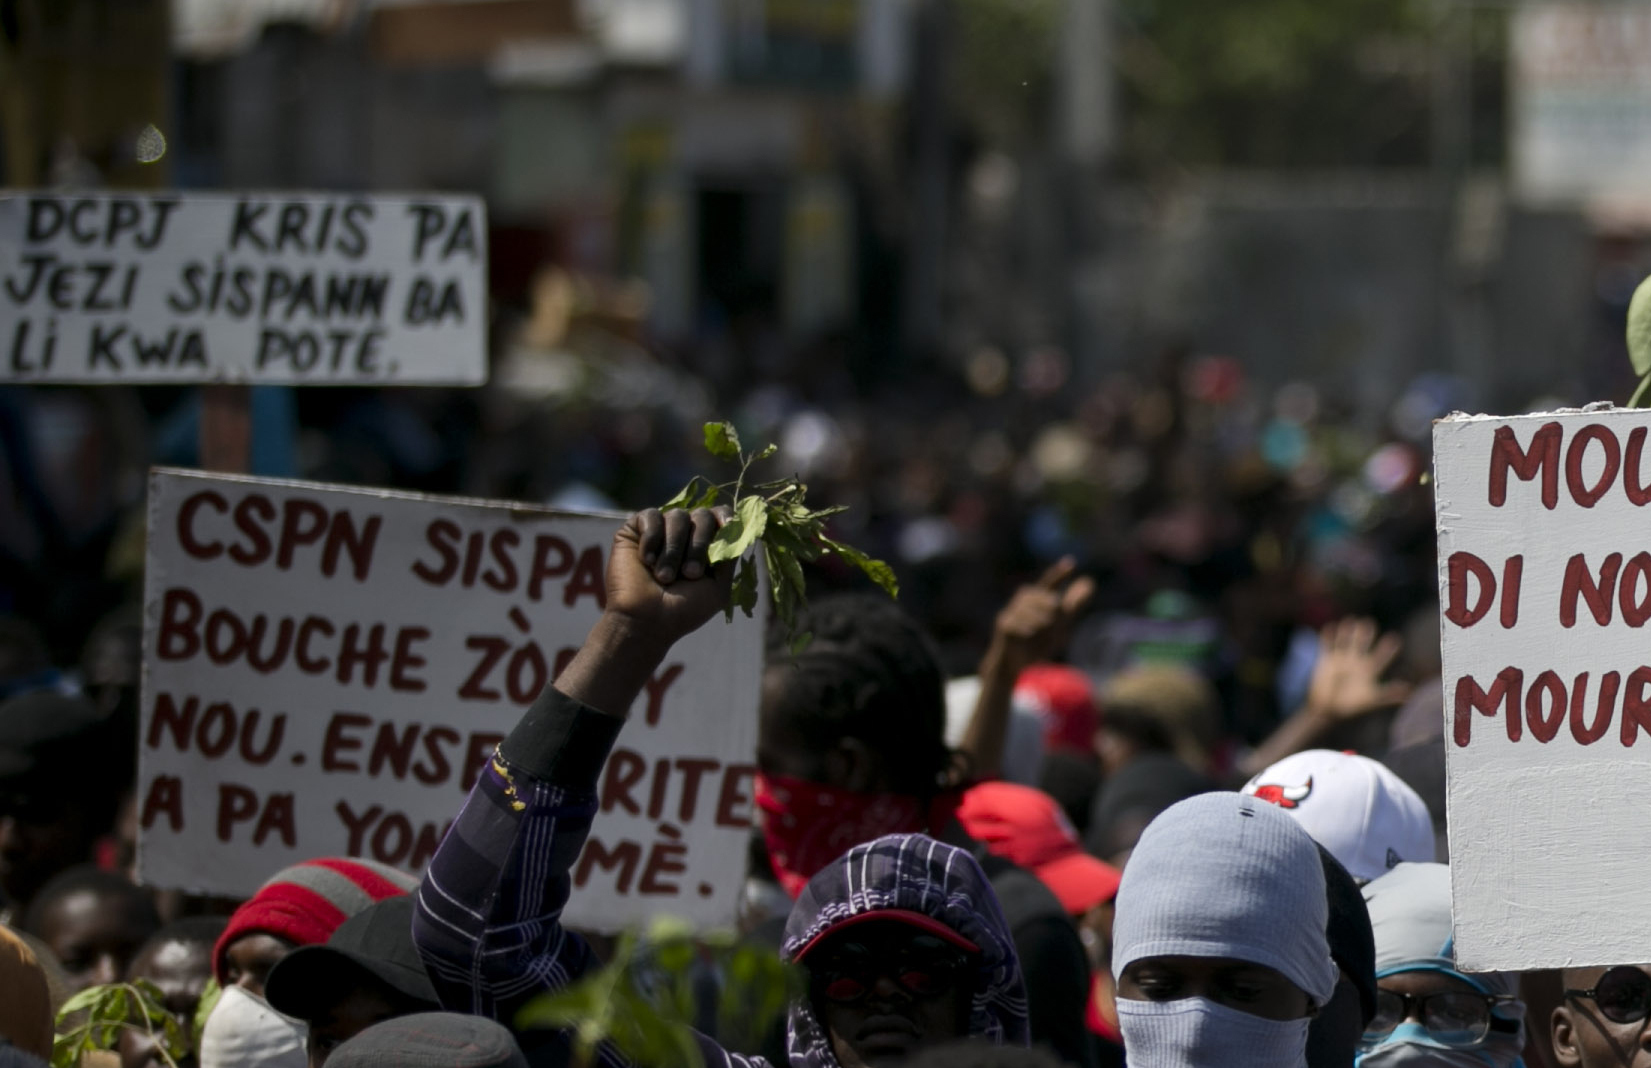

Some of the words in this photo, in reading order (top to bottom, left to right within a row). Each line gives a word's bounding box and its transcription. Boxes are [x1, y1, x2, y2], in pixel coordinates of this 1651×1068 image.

[26, 199, 178, 250] DCPJ
[229, 200, 374, 260] KRIS
[408, 203, 478, 261] PA
[5, 254, 138, 310] JEZI
[405, 276, 466, 326] BA
[177, 490, 382, 583] CSPN
[411, 518, 607, 610] SISPA
[1445, 551, 1523, 628] DI
[156, 588, 430, 693] BOUCHE
[141, 775, 184, 833] A
[217, 783, 296, 848] PA
